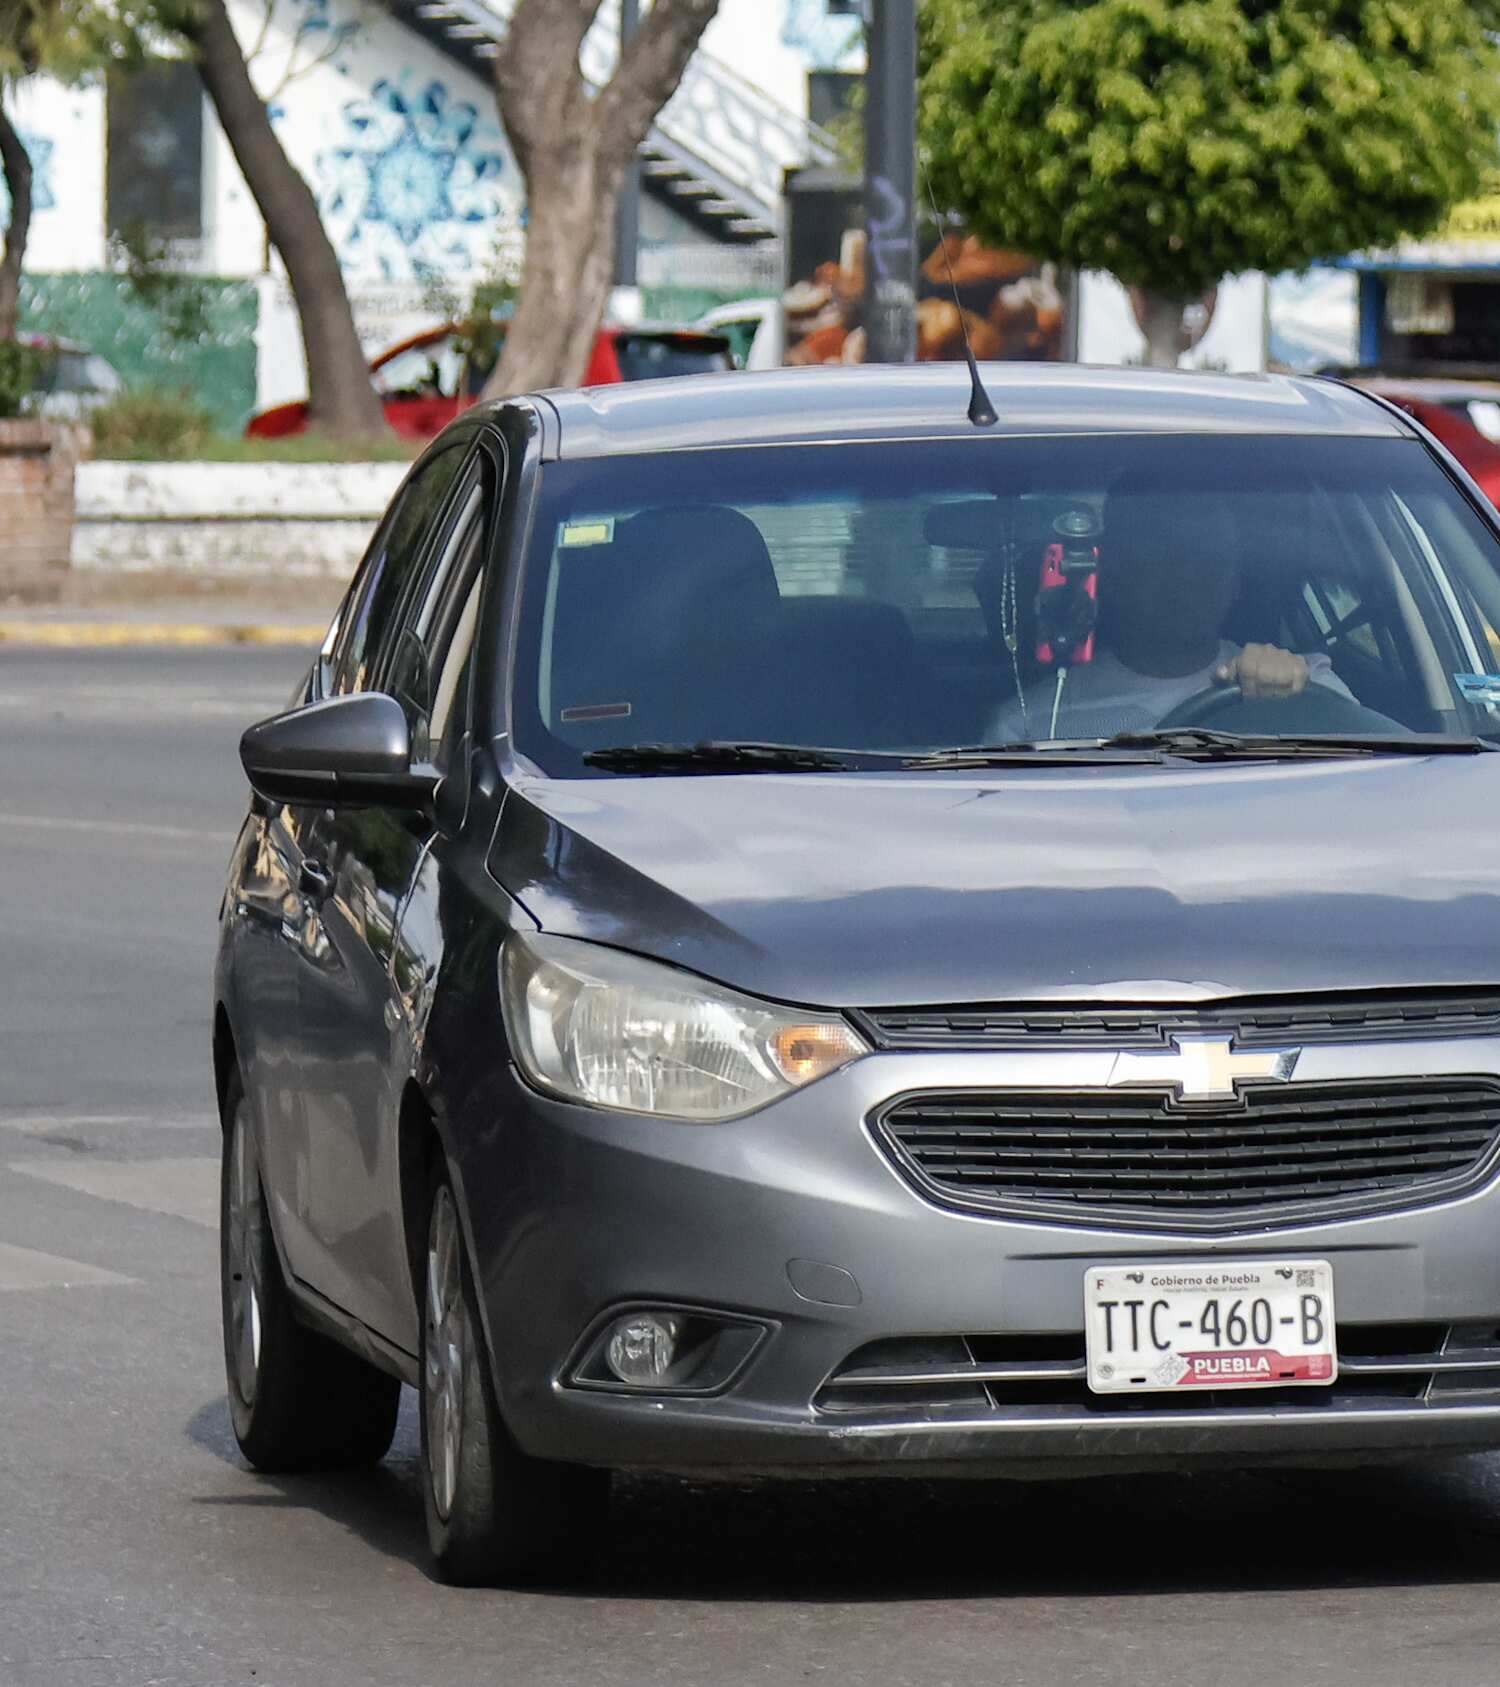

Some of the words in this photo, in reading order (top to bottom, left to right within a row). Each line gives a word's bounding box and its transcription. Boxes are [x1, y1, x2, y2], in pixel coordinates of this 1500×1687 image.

[1096, 1279, 1104, 1290] F
[1151, 1276, 1204, 1287] Gobierno
[1206, 1275, 1219, 1285] de
[1222, 1274, 1260, 1285] Puebla
[1097, 1294, 1324, 1353] TTC-460-B
[1193, 1356, 1271, 1374] PUEBLA
